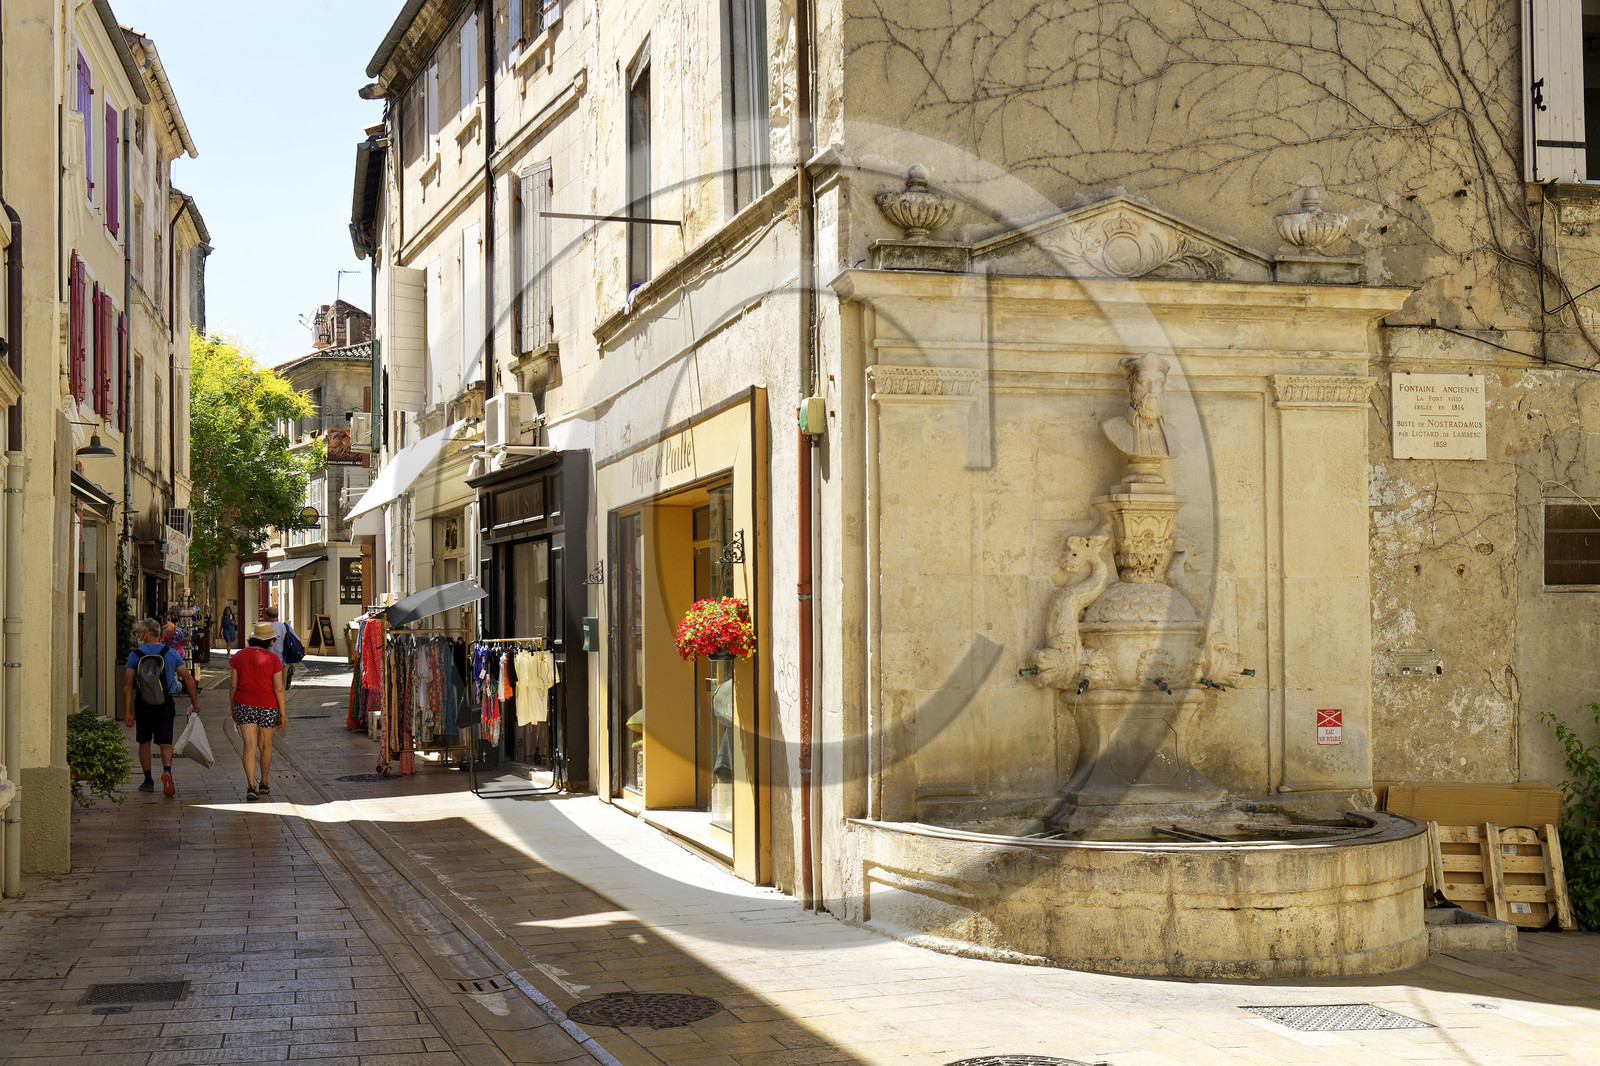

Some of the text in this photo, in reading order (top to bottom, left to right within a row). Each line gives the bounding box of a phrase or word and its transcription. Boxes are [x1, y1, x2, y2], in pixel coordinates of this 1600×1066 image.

[1399, 383, 1435, 393] FONTAINE
[1427, 419, 1483, 429] NOSTRADAMUS
[1453, 430, 1481, 438] LAMBESC
